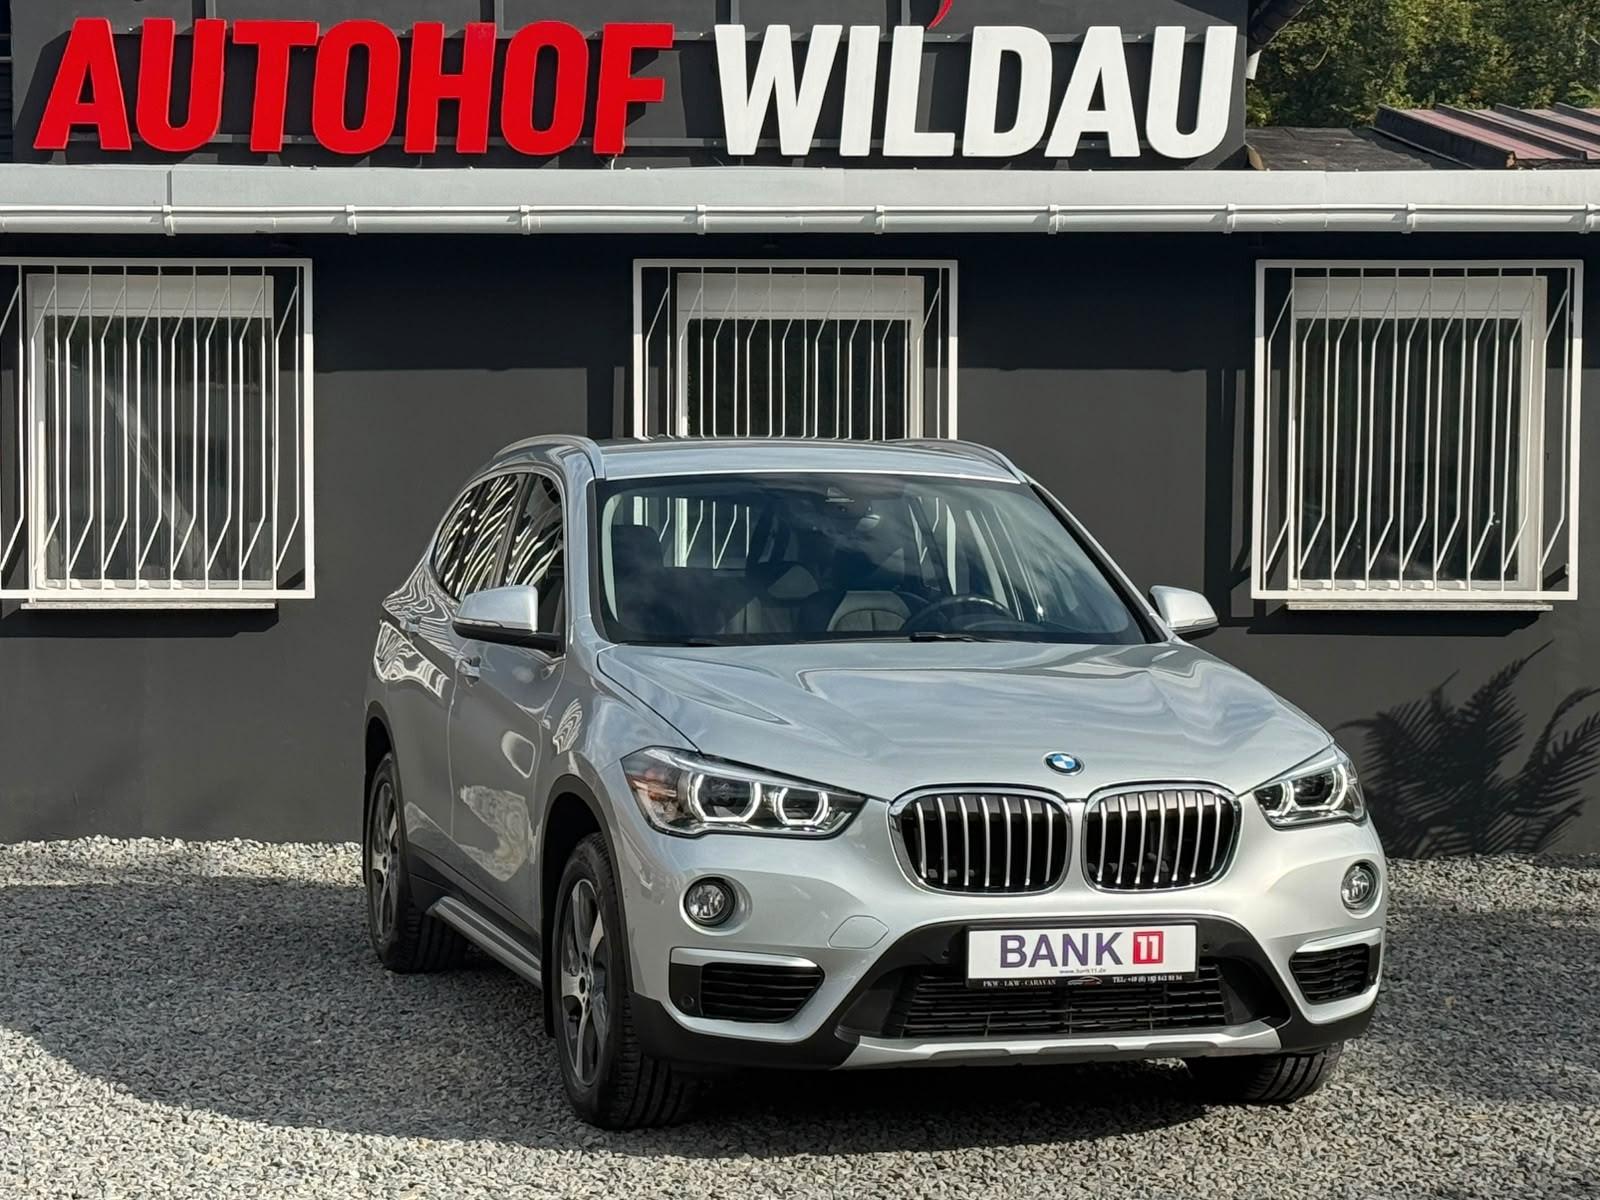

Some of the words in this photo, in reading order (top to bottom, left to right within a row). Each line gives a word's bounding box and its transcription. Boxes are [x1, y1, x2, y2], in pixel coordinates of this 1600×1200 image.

[33, 18, 675, 155] AUTOHOF
[714, 25, 1238, 160] WILDAU
[1000, 932, 1123, 968] BANK
[1136, 934, 1160, 961] 11
